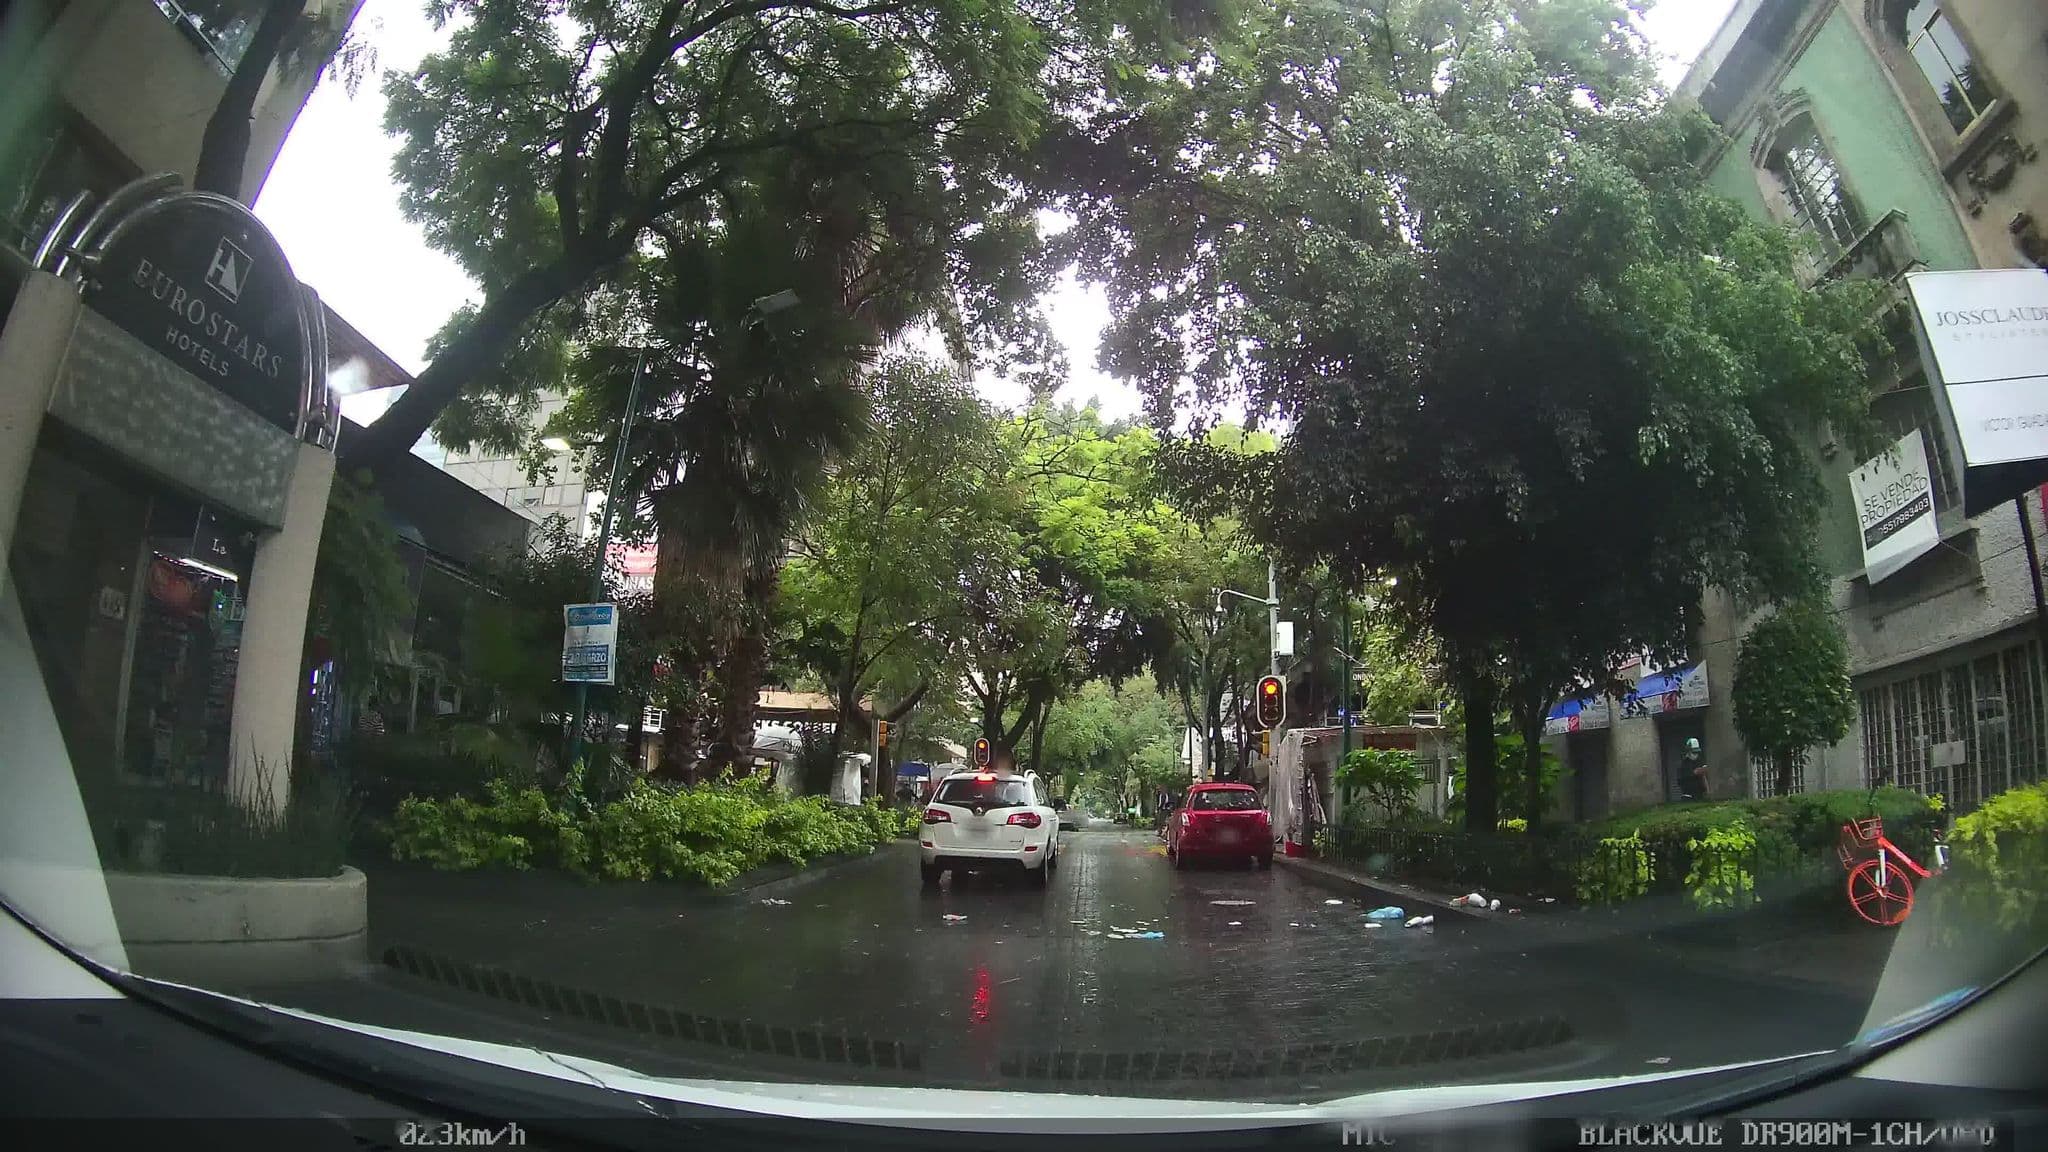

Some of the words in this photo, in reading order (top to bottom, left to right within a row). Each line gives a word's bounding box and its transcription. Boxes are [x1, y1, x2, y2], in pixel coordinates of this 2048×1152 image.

[134, 258, 282, 378] EUROSTARS
[166, 327, 230, 377] HOTELS
[1861, 476, 1928, 528] PROPIEDAD
[1864, 494, 1880, 512] SE
